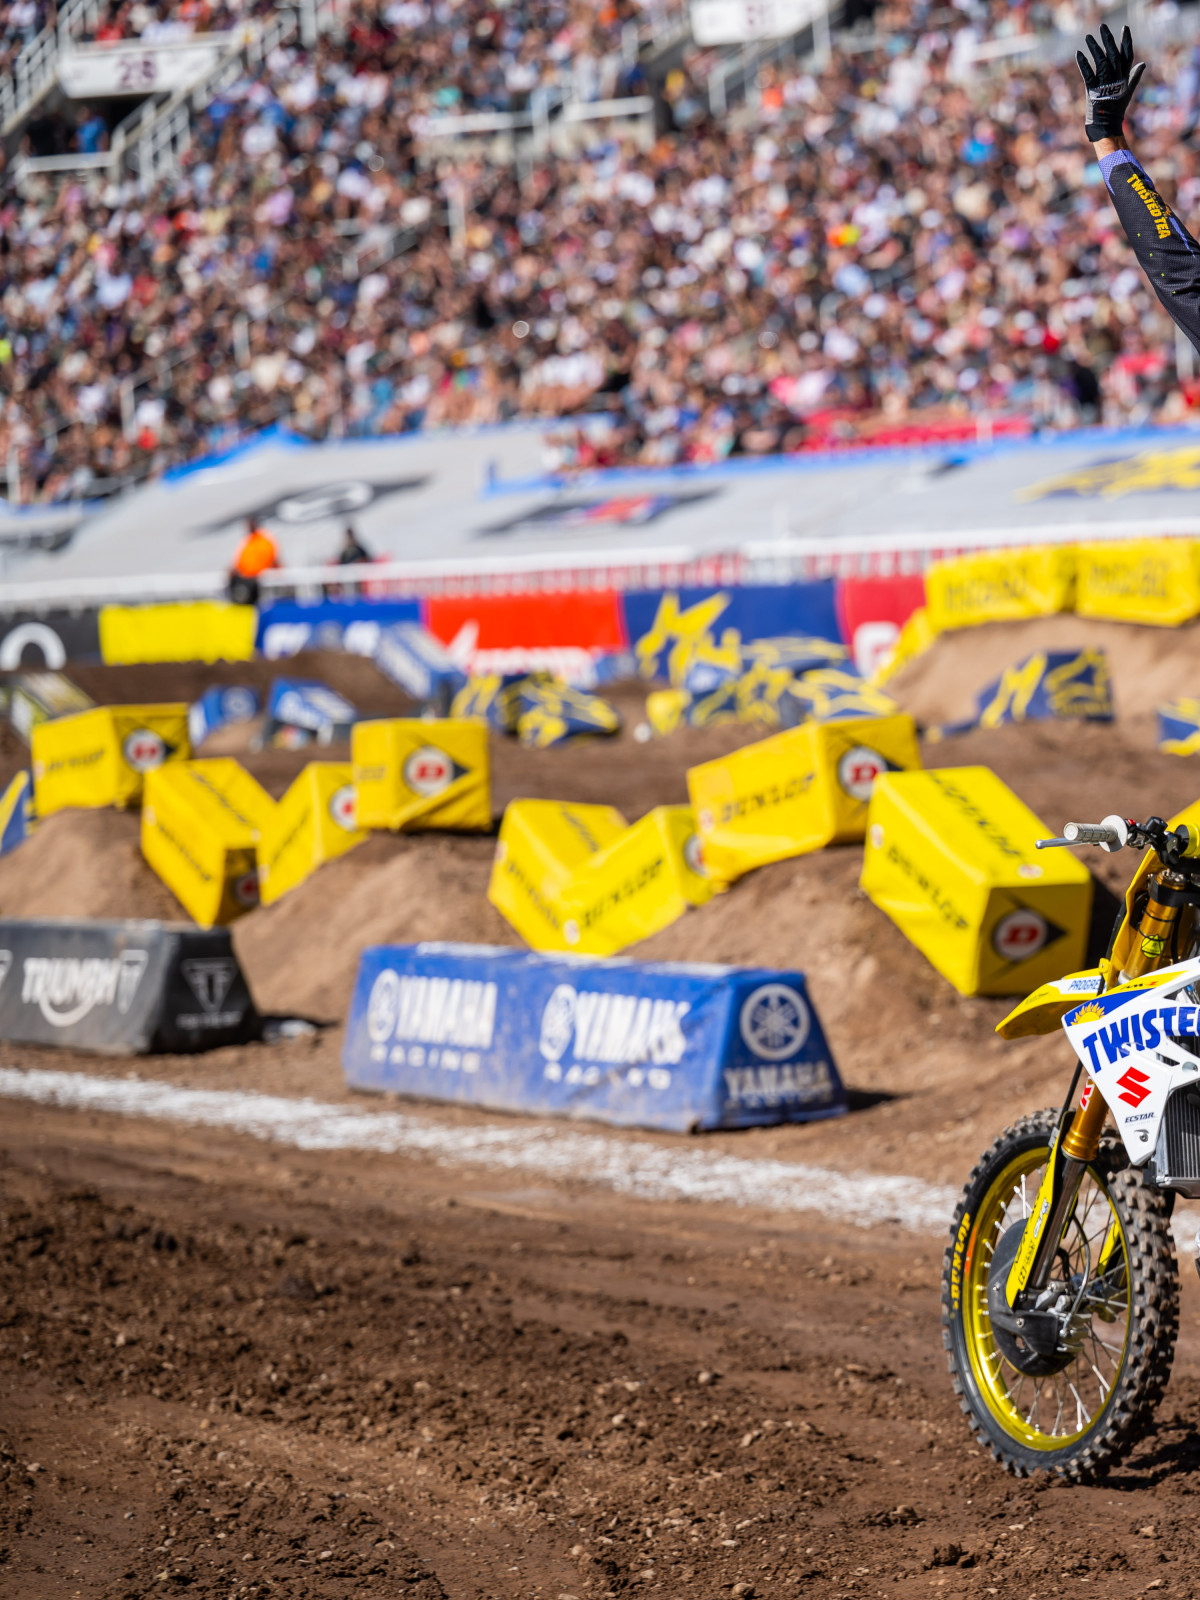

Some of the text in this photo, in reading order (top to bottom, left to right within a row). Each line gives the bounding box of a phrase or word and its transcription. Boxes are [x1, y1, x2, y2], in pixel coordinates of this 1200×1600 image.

[1126, 173, 1172, 240] TWISTED TEA
[719, 772, 816, 825] DUNLOP
[849, 763, 879, 785] D
[887, 843, 969, 931] DUNLOP
[1003, 923, 1041, 945] D
[21, 956, 121, 1014] TRIUMPH
[1068, 978, 1106, 992] PROGRE
[396, 975, 499, 1050] YAMAHA
[369, 1042, 481, 1075] RACING
[1125, 1111, 1155, 1124] ECSTAR
[950, 1212, 971, 1300] DUNLOP
